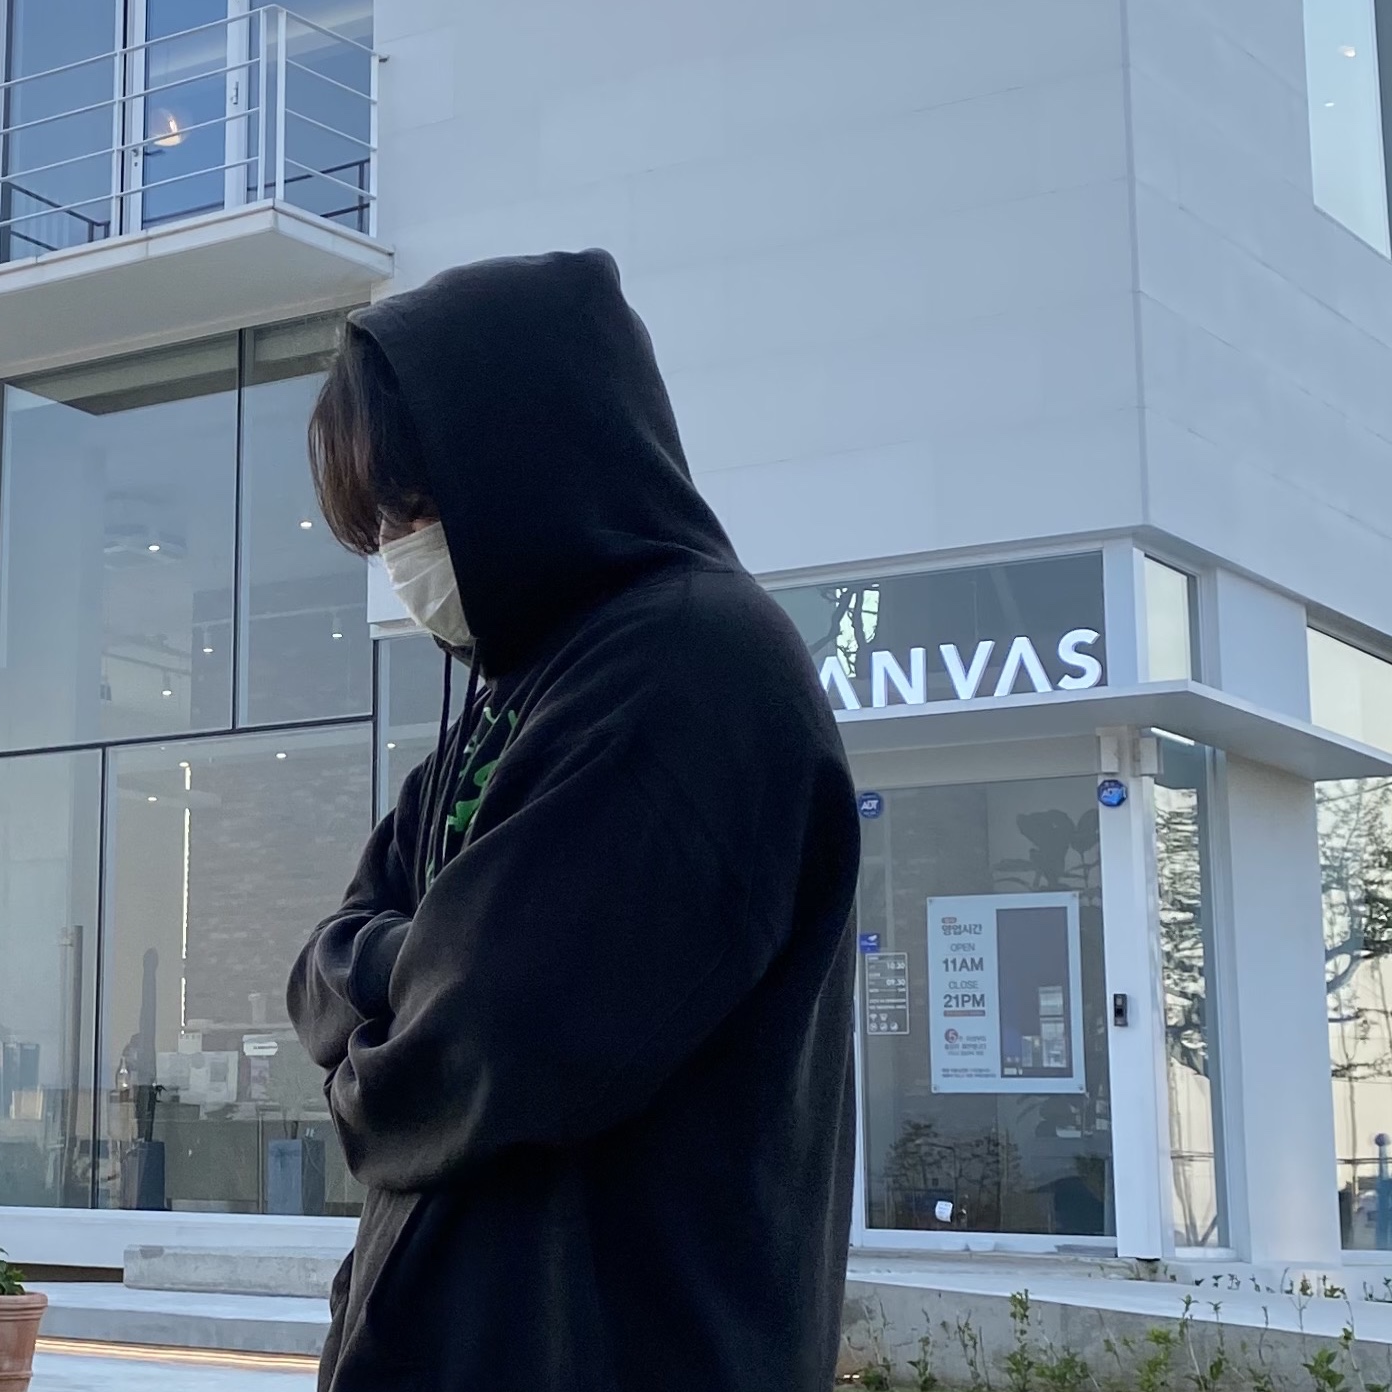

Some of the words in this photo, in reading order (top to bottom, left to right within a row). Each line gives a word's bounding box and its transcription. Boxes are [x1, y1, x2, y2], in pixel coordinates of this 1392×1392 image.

[861, 799, 879, 811] ADT
[941, 923, 983, 936] 영업시간
[950, 943, 976, 952] OPEN
[942, 957, 984, 972] 11AM
[948, 980, 979, 990] CLOSE
[943, 993, 986, 1008] 21PM
